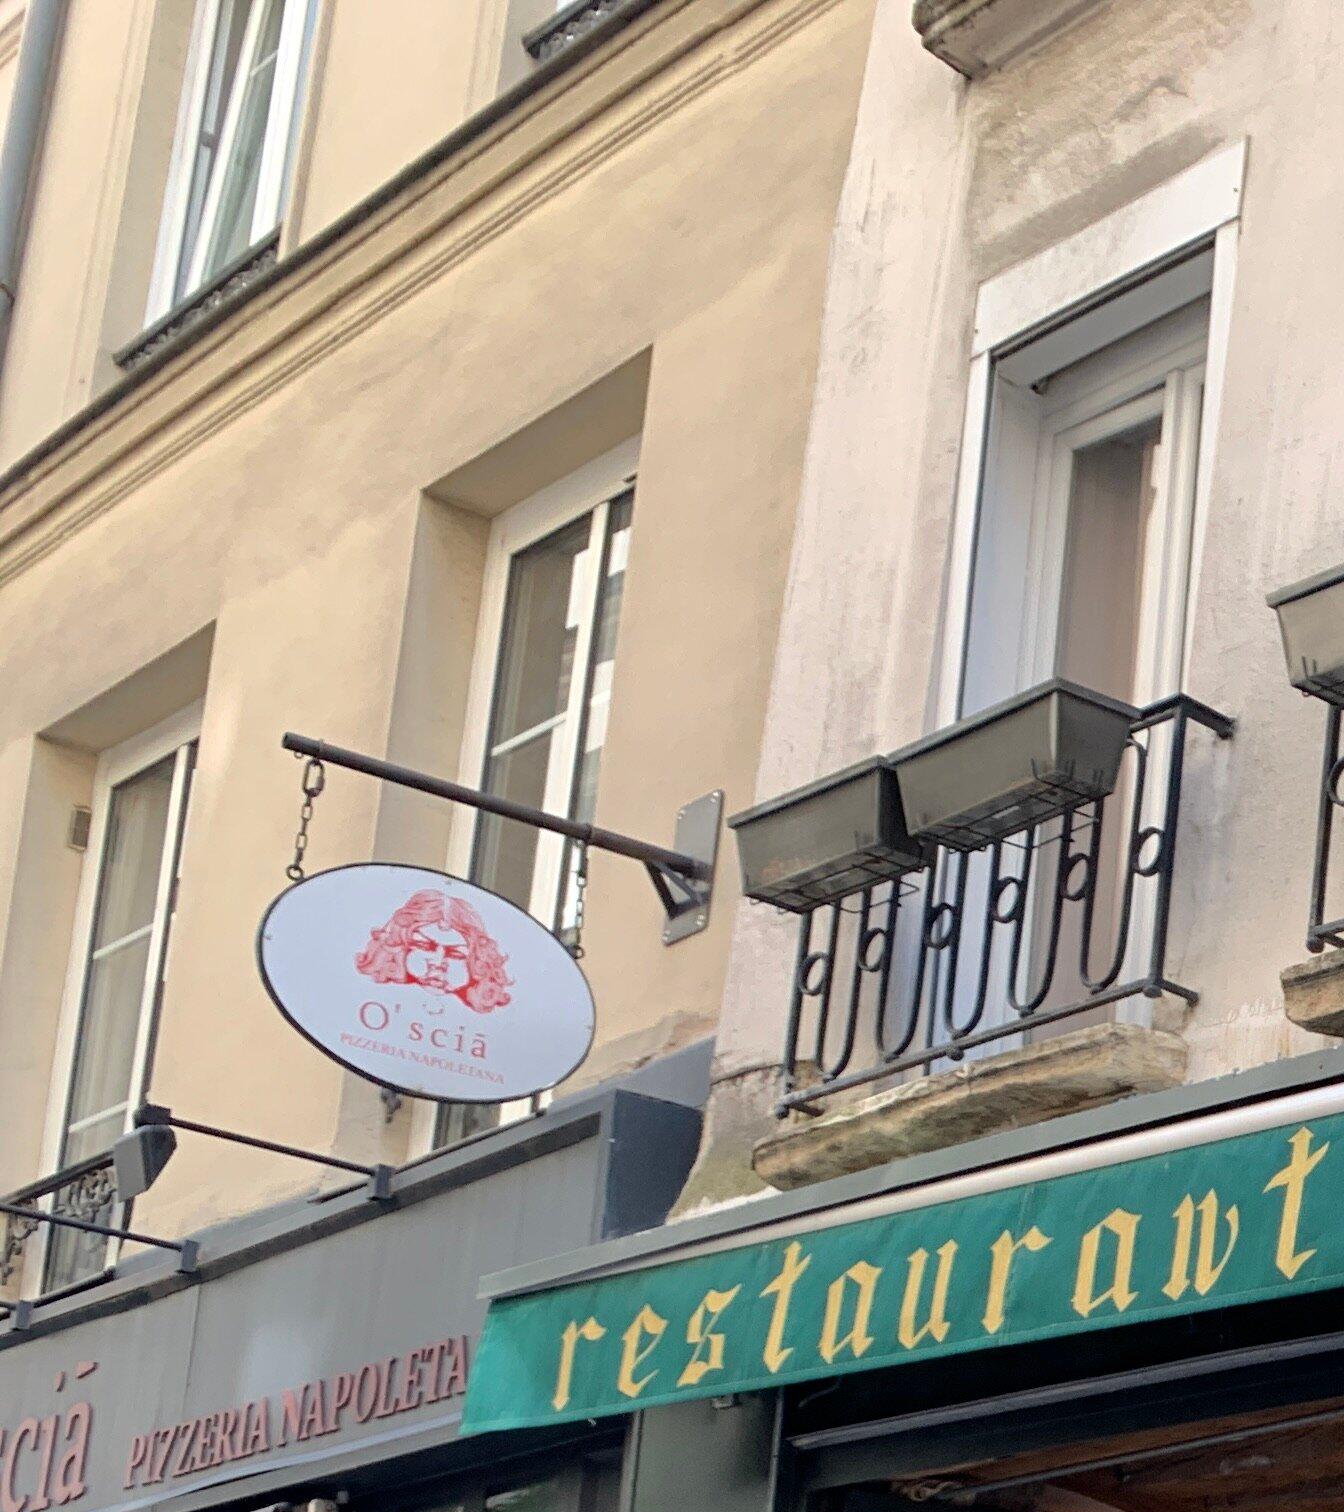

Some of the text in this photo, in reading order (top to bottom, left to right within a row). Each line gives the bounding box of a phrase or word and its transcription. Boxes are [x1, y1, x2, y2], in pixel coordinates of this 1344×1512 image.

[340, 1032, 504, 1085] PIZZERIA NAPOLETANA
[552, 1125, 1330, 1412] restaurant
[124, 1397, 270, 1490] PIZZERIA
[277, 1334, 479, 1448] NAPOLETA
